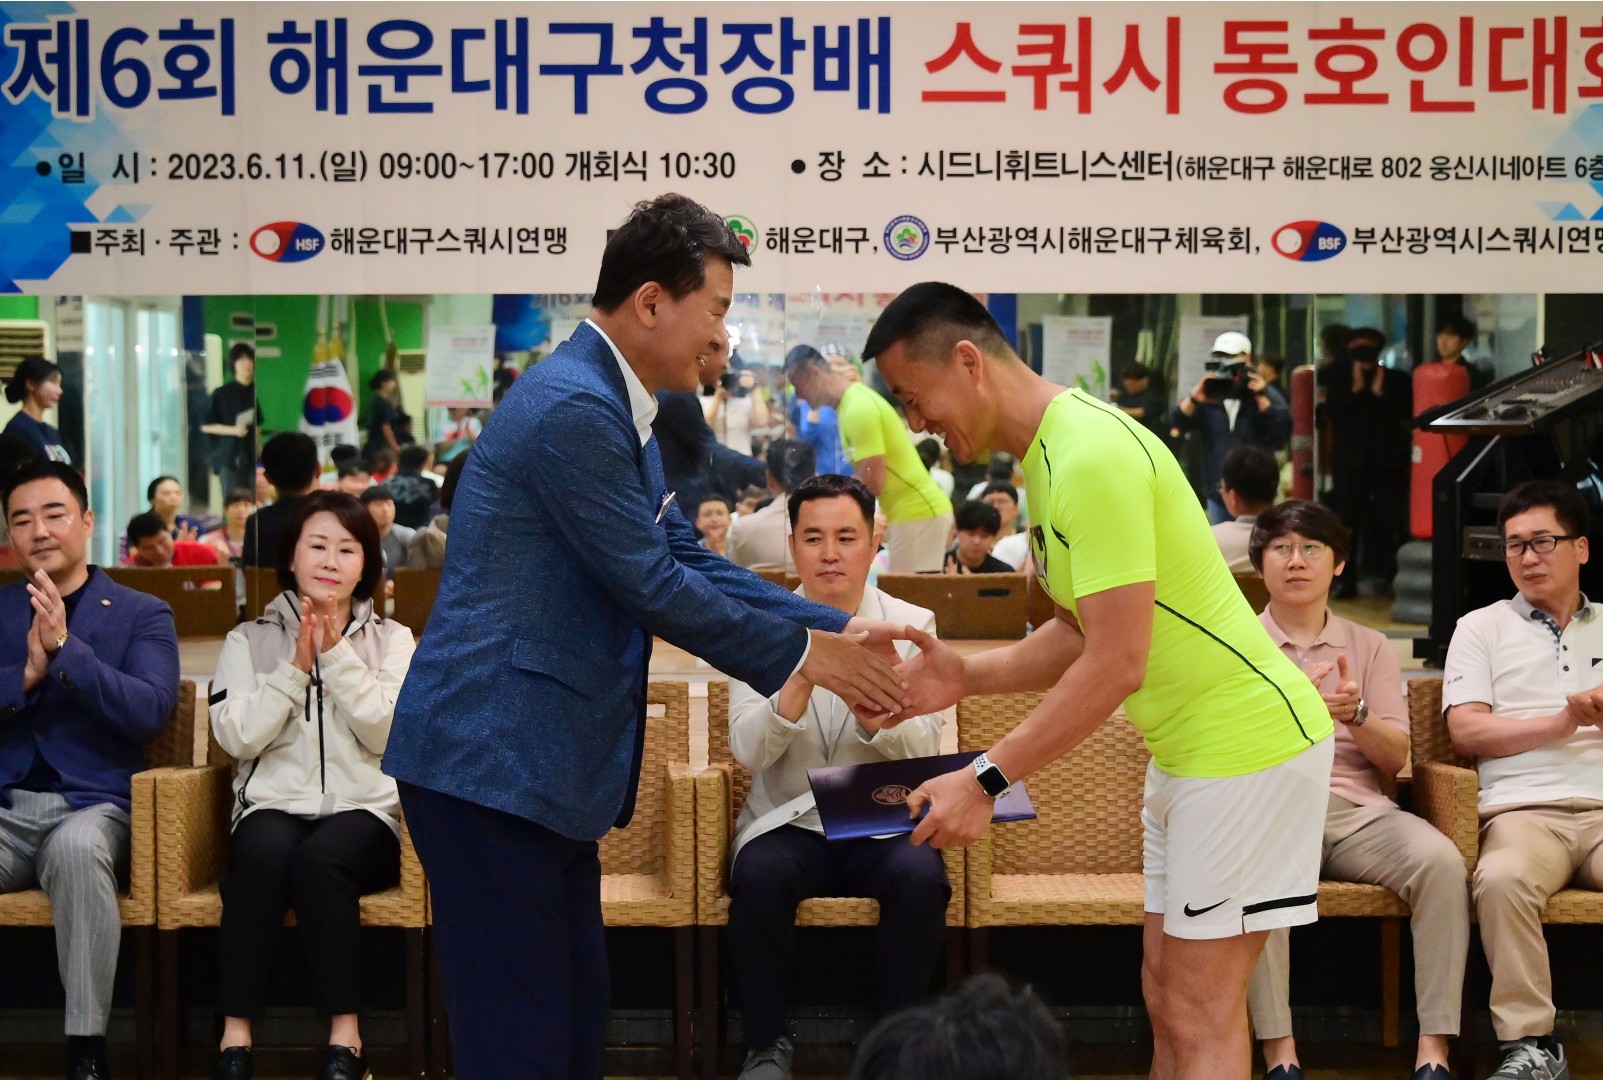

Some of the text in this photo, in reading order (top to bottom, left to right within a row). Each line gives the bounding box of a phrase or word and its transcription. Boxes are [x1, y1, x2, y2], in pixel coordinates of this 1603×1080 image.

[8, 18, 236, 116] 제6회
[268, 17, 891, 116] 해운대구청장배
[921, 16, 1181, 116] 스쿼시
[379, 152, 554, 179] 09:00~17:00
[565, 151, 647, 181] 개회식
[660, 152, 736, 178] 10:30
[818, 151, 846, 182] 장
[1283, 155, 1374, 181] 해운대로
[1381, 157, 1422, 178] 802
[1429, 155, 1568, 181] 웅신시네아트
[296, 237, 319, 251] HSF
[330, 227, 567, 257] 해운대구스쿼시연맹
[934, 225, 1260, 256] 부산광역시해운대구체육회,
[1318, 236, 1341, 251] BSF
